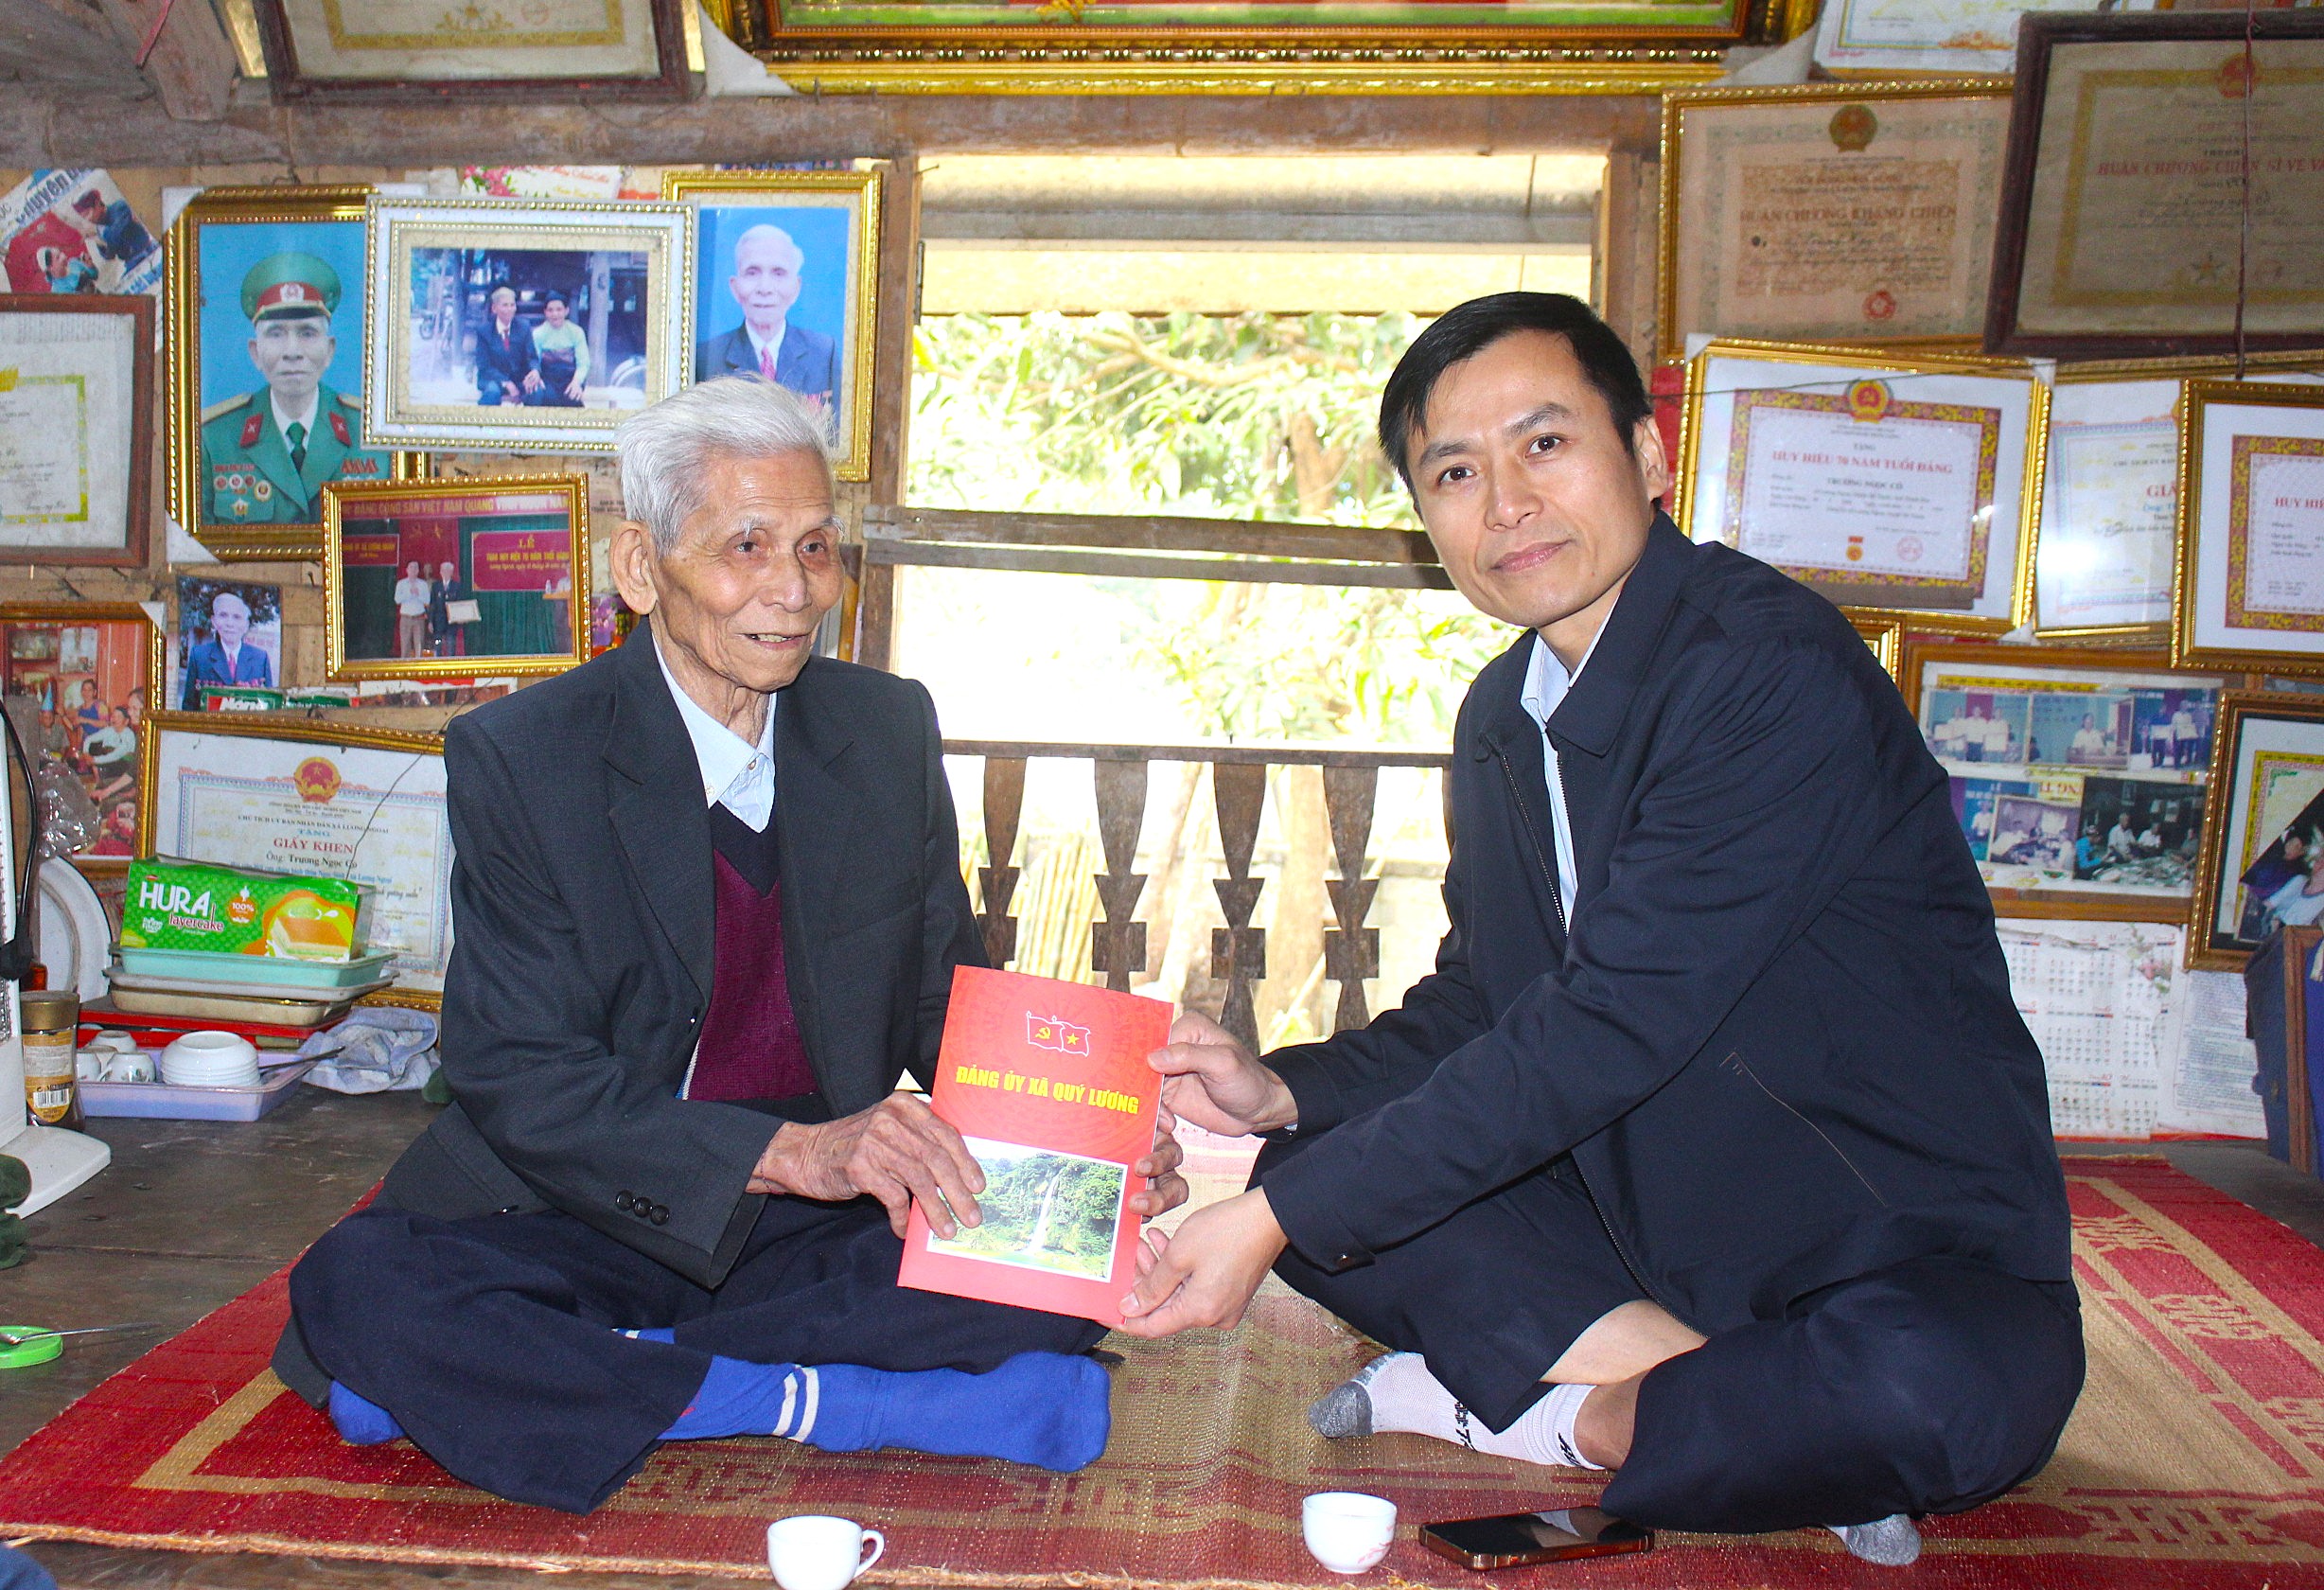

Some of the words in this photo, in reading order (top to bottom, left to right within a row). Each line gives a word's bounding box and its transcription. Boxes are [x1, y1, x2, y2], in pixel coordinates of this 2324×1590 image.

[1772, 450, 1799, 463] HUY
[273, 835, 308, 851] GIẤY
[313, 840, 354, 854] KHEN
[138, 881, 211, 917] HURA
[231, 902, 255, 912] 100%
[168, 903, 225, 932] layercake
[956, 1064, 1000, 1088] ĐẢNG
[1003, 1069, 1026, 1092] ỦY
[1027, 1077, 1048, 1097] XÃ
[1052, 1082, 1085, 1104] QUÝ
[1088, 1087, 1139, 1115] LƯƠNG
